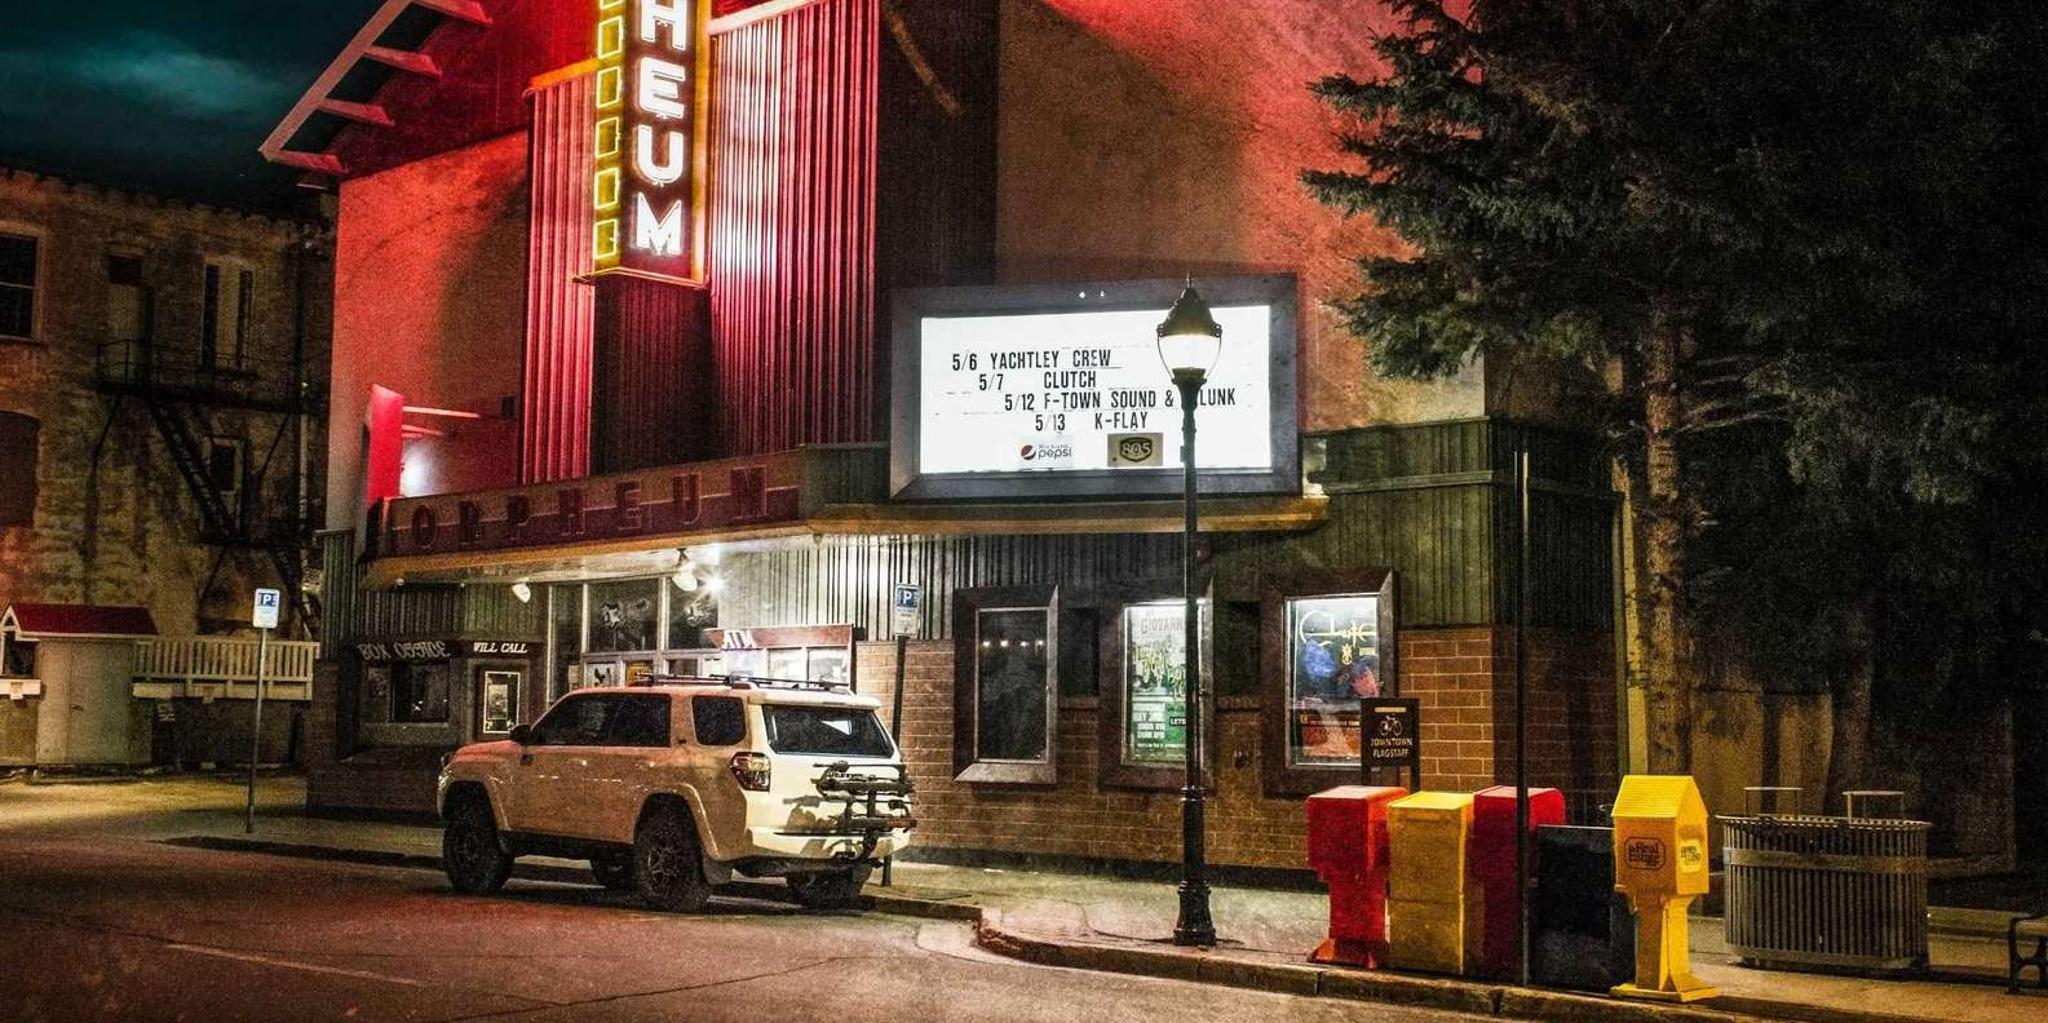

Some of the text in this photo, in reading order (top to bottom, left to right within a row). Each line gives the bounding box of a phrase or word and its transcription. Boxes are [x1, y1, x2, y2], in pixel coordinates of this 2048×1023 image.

[952, 350, 1111, 371] 5/6 YACHTLEY CREW
[979, 371, 1096, 391] 5/7 CLUTCH
[1004, 388, 1236, 411] 5/12 F-TOWN SOUND & LUNK
[1035, 412, 1148, 431] 5/13 K-FLAY
[1038, 447, 1072, 460] pepsi
[1122, 443, 1151, 455] 805
[411, 466, 769, 551] ORPHEUM
[474, 642, 527, 654] WILL CALL
[1371, 737, 1413, 747] DOWNTOWN
[1373, 748, 1409, 758] FLAGSTAFF
